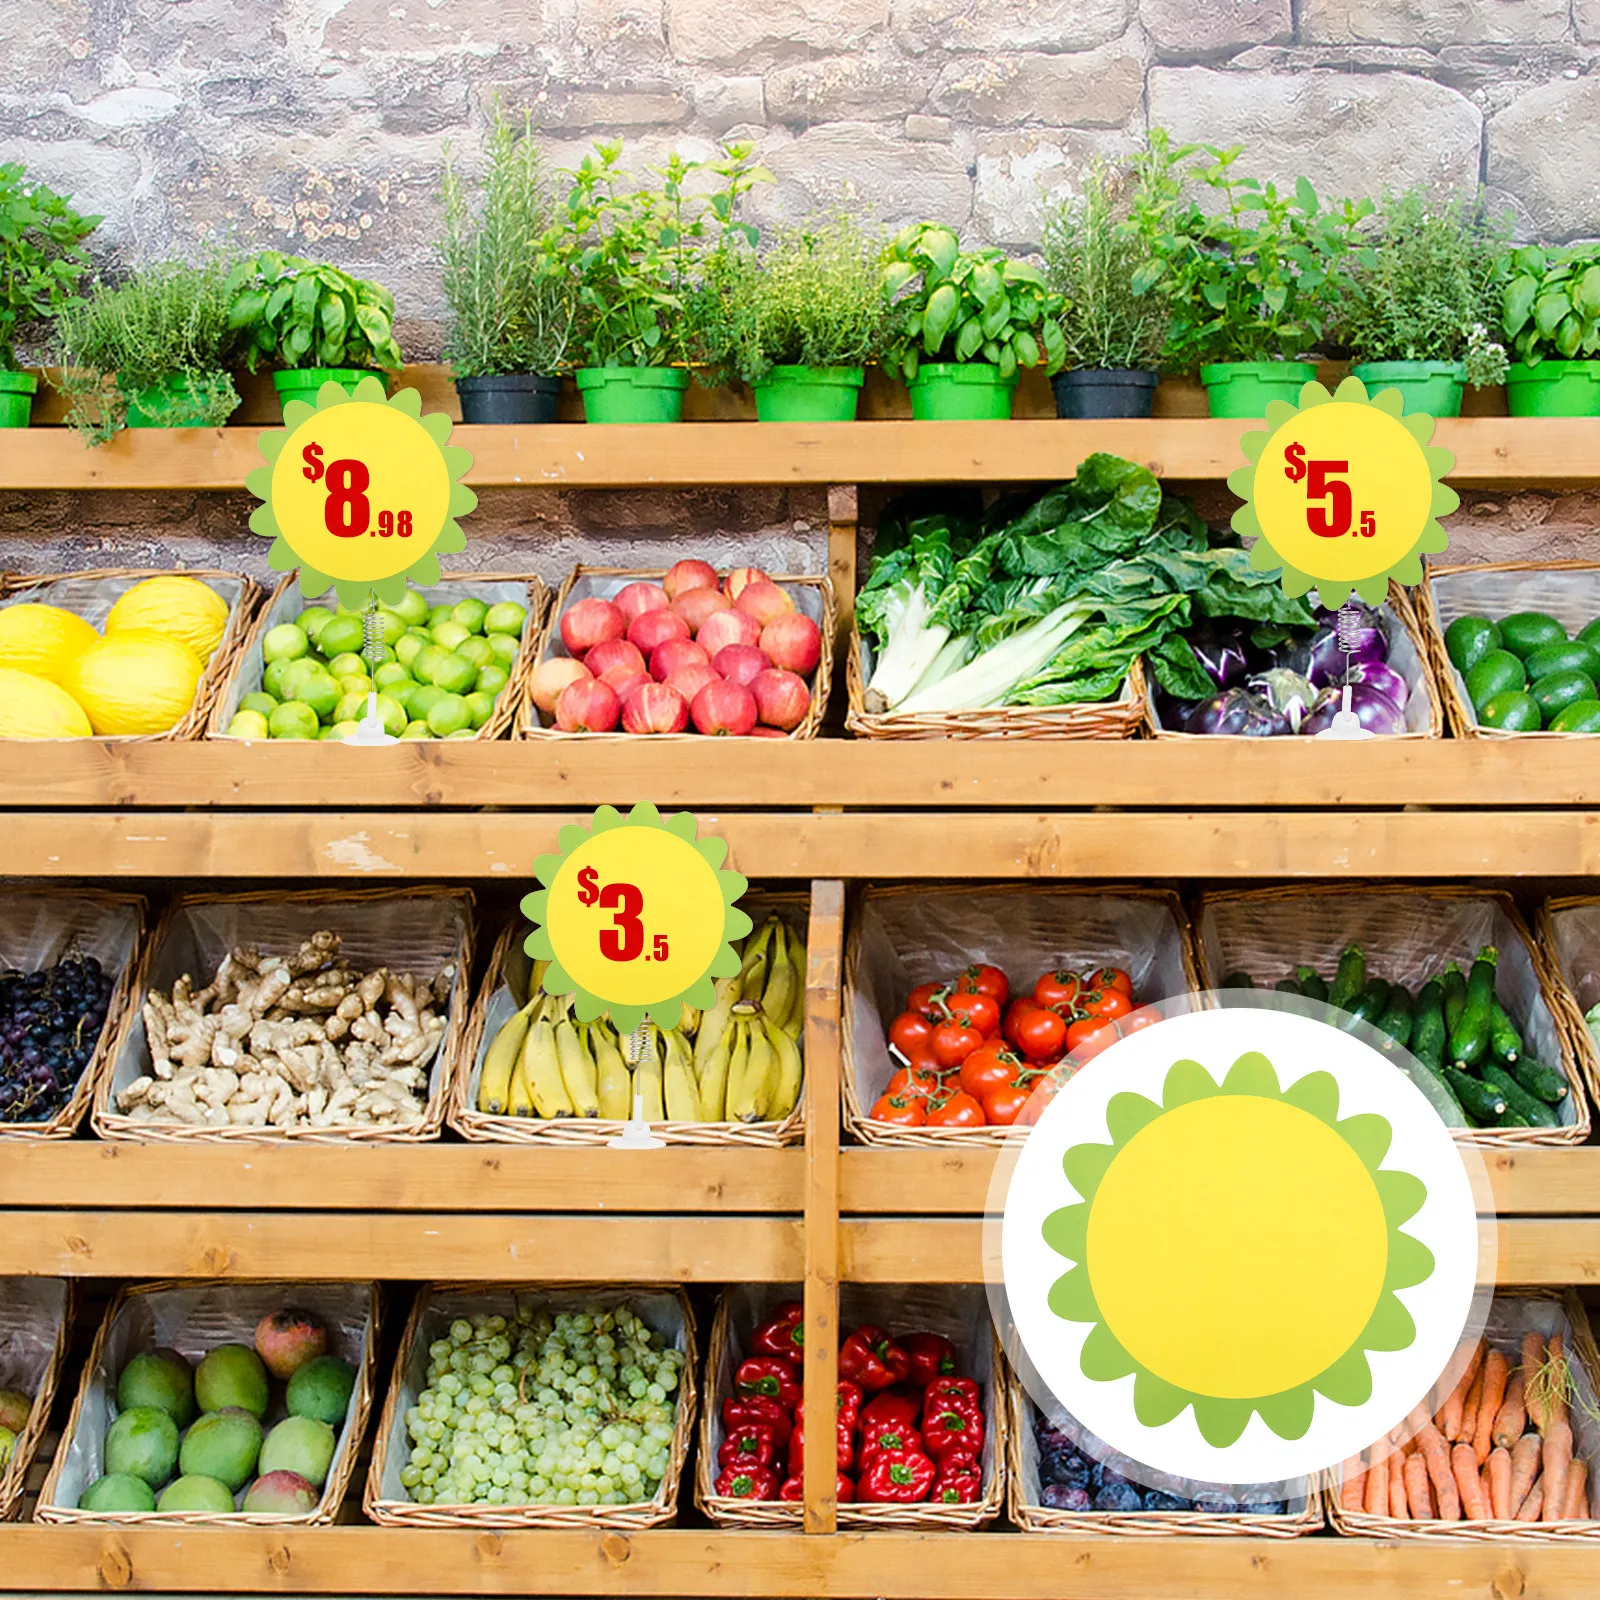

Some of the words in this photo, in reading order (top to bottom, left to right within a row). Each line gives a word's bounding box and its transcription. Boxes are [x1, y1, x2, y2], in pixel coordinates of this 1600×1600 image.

[302, 441, 413, 538] $8.98
[1284, 441, 1376, 538] $5.5
[577, 865, 669, 962] $3.5
